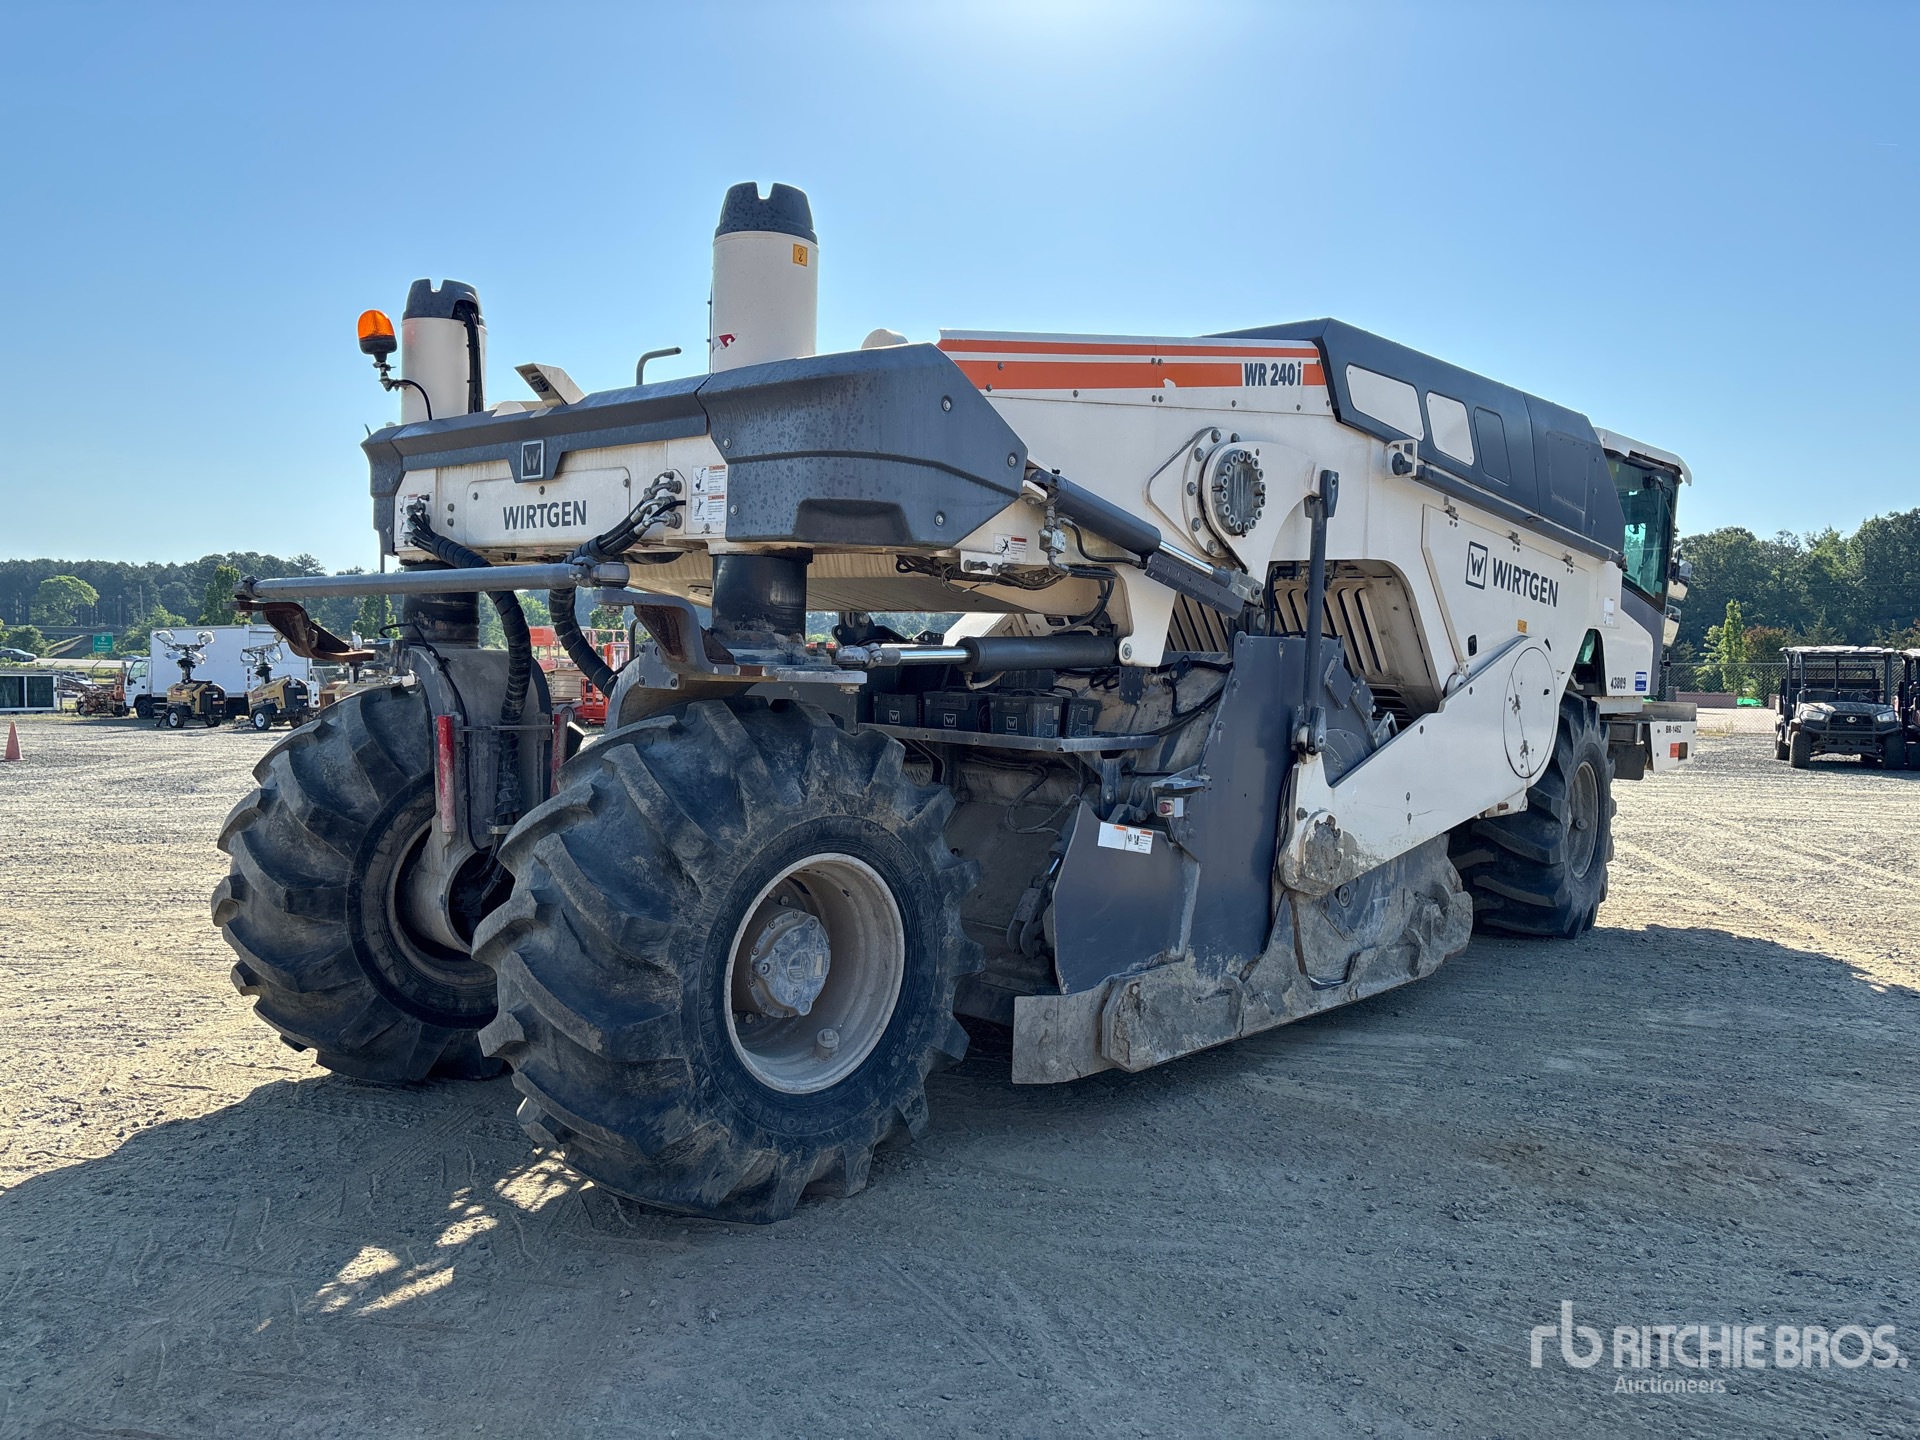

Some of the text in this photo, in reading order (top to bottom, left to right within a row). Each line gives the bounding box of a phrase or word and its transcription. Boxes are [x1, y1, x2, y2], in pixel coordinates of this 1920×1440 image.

[1244, 362, 1267, 386] WR
[503, 500, 587, 530] WIRTGEN
[1492, 557, 1559, 608] WIRTGEN
